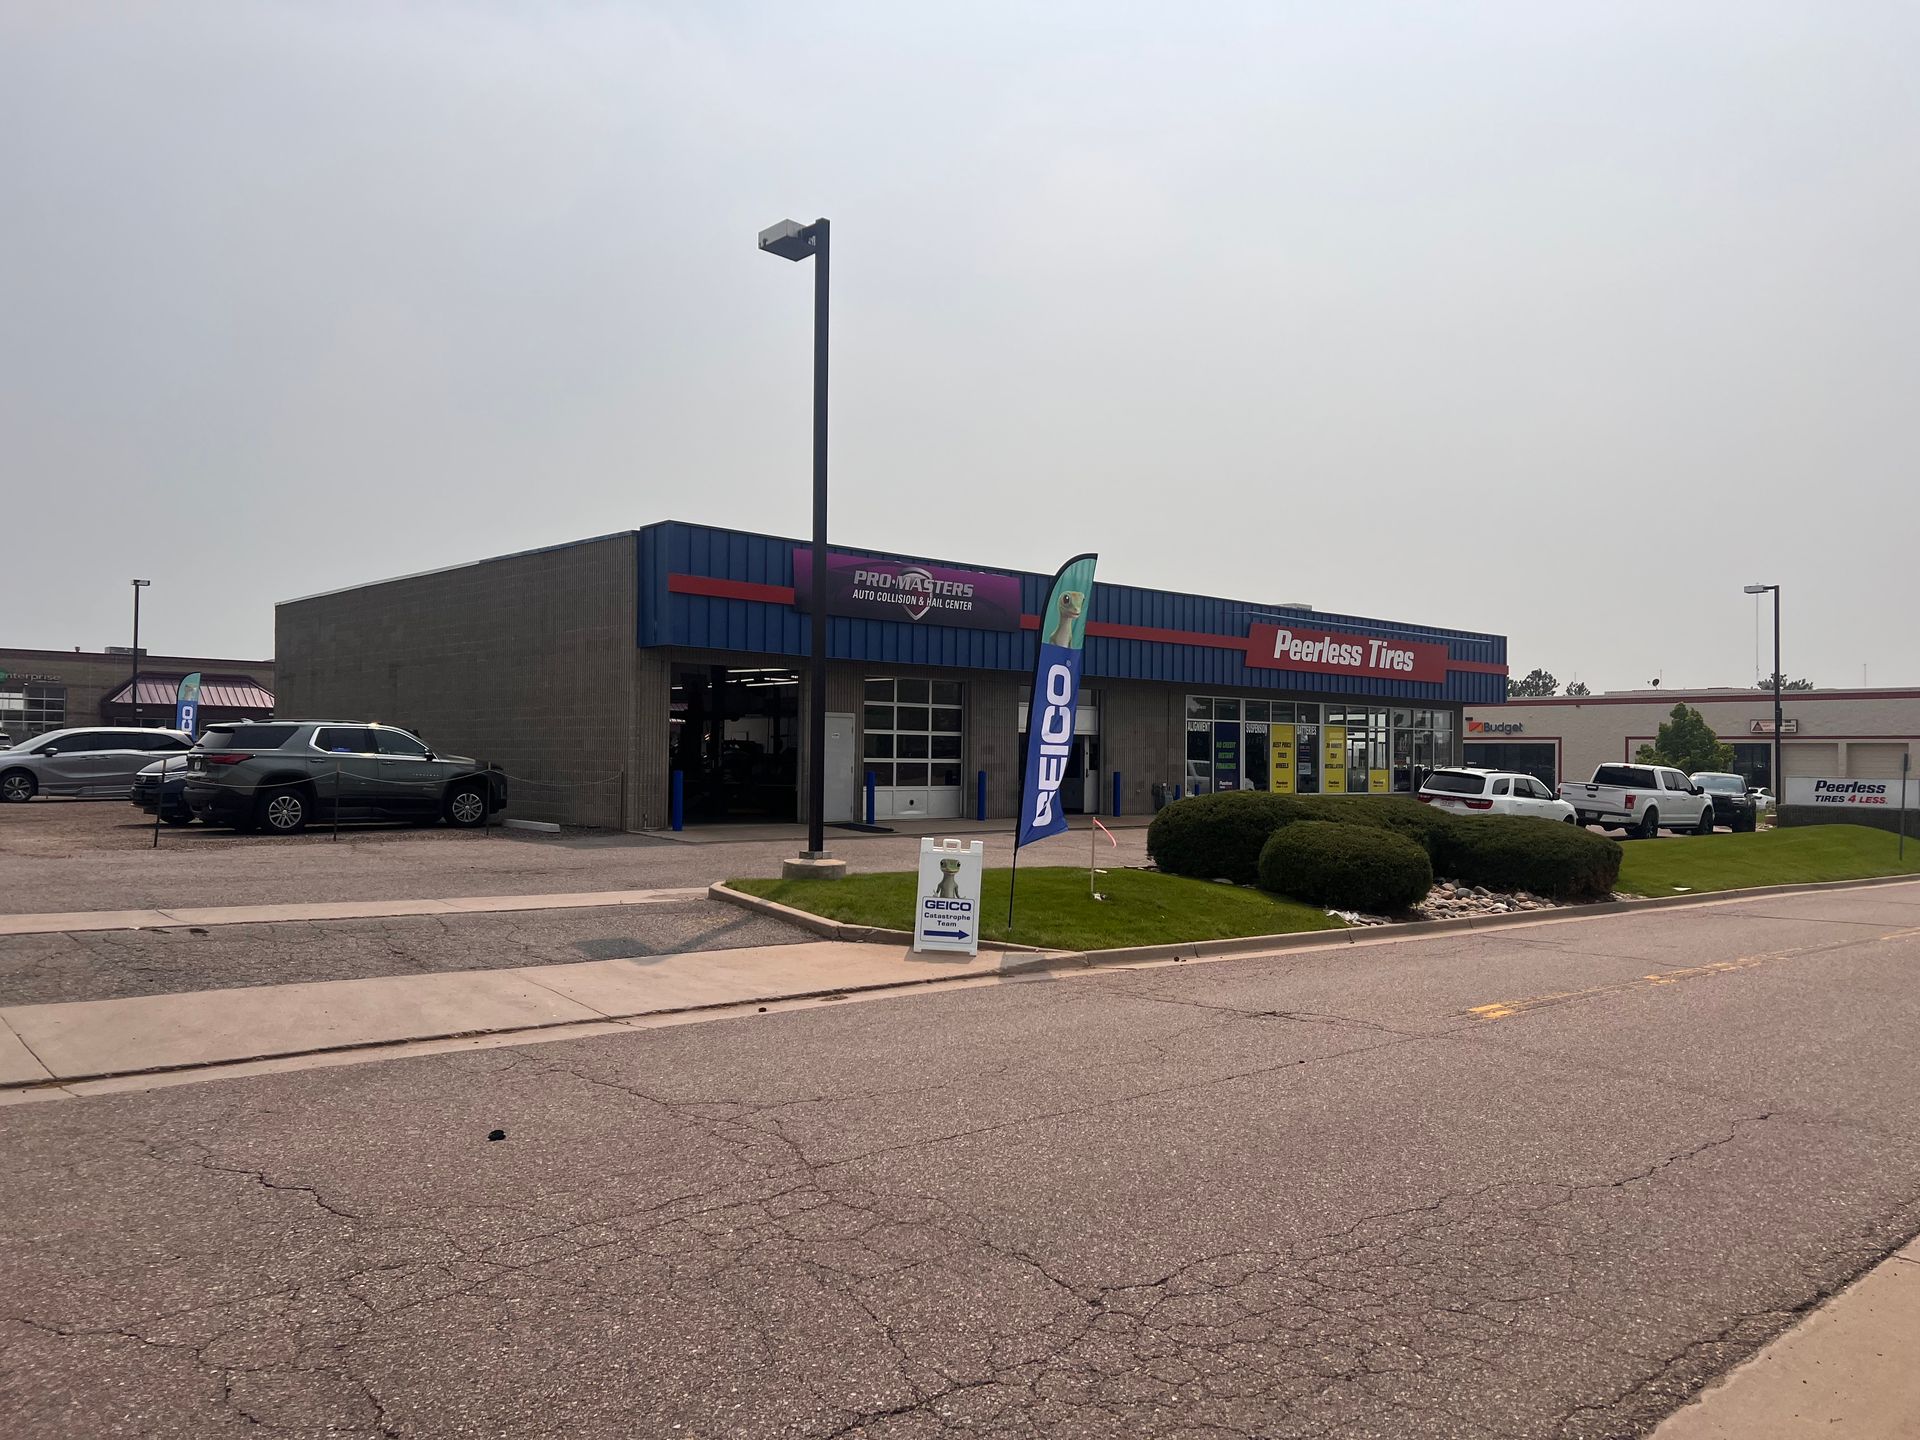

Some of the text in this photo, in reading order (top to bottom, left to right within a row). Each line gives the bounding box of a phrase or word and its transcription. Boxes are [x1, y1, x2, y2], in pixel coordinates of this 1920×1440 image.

[852, 589, 972, 611] AUTO COLLISION & HAIL CENTER
[1273, 629, 1415, 672] Peerless Tires
[1187, 721, 1211, 732] ALIGNMENT
[1245, 723, 1268, 735] SUSPENSION
[1297, 725, 1317, 736] BATTERIES
[1483, 722, 1524, 736] Budget
[1032, 664, 1071, 827] GEICO
[1814, 780, 1887, 794] Peerless
[1815, 794, 1845, 803] TIRES
[1847, 794, 1857, 803] 4
[925, 899, 972, 911] GEICO
[924, 912, 971, 921] Catastrophe
